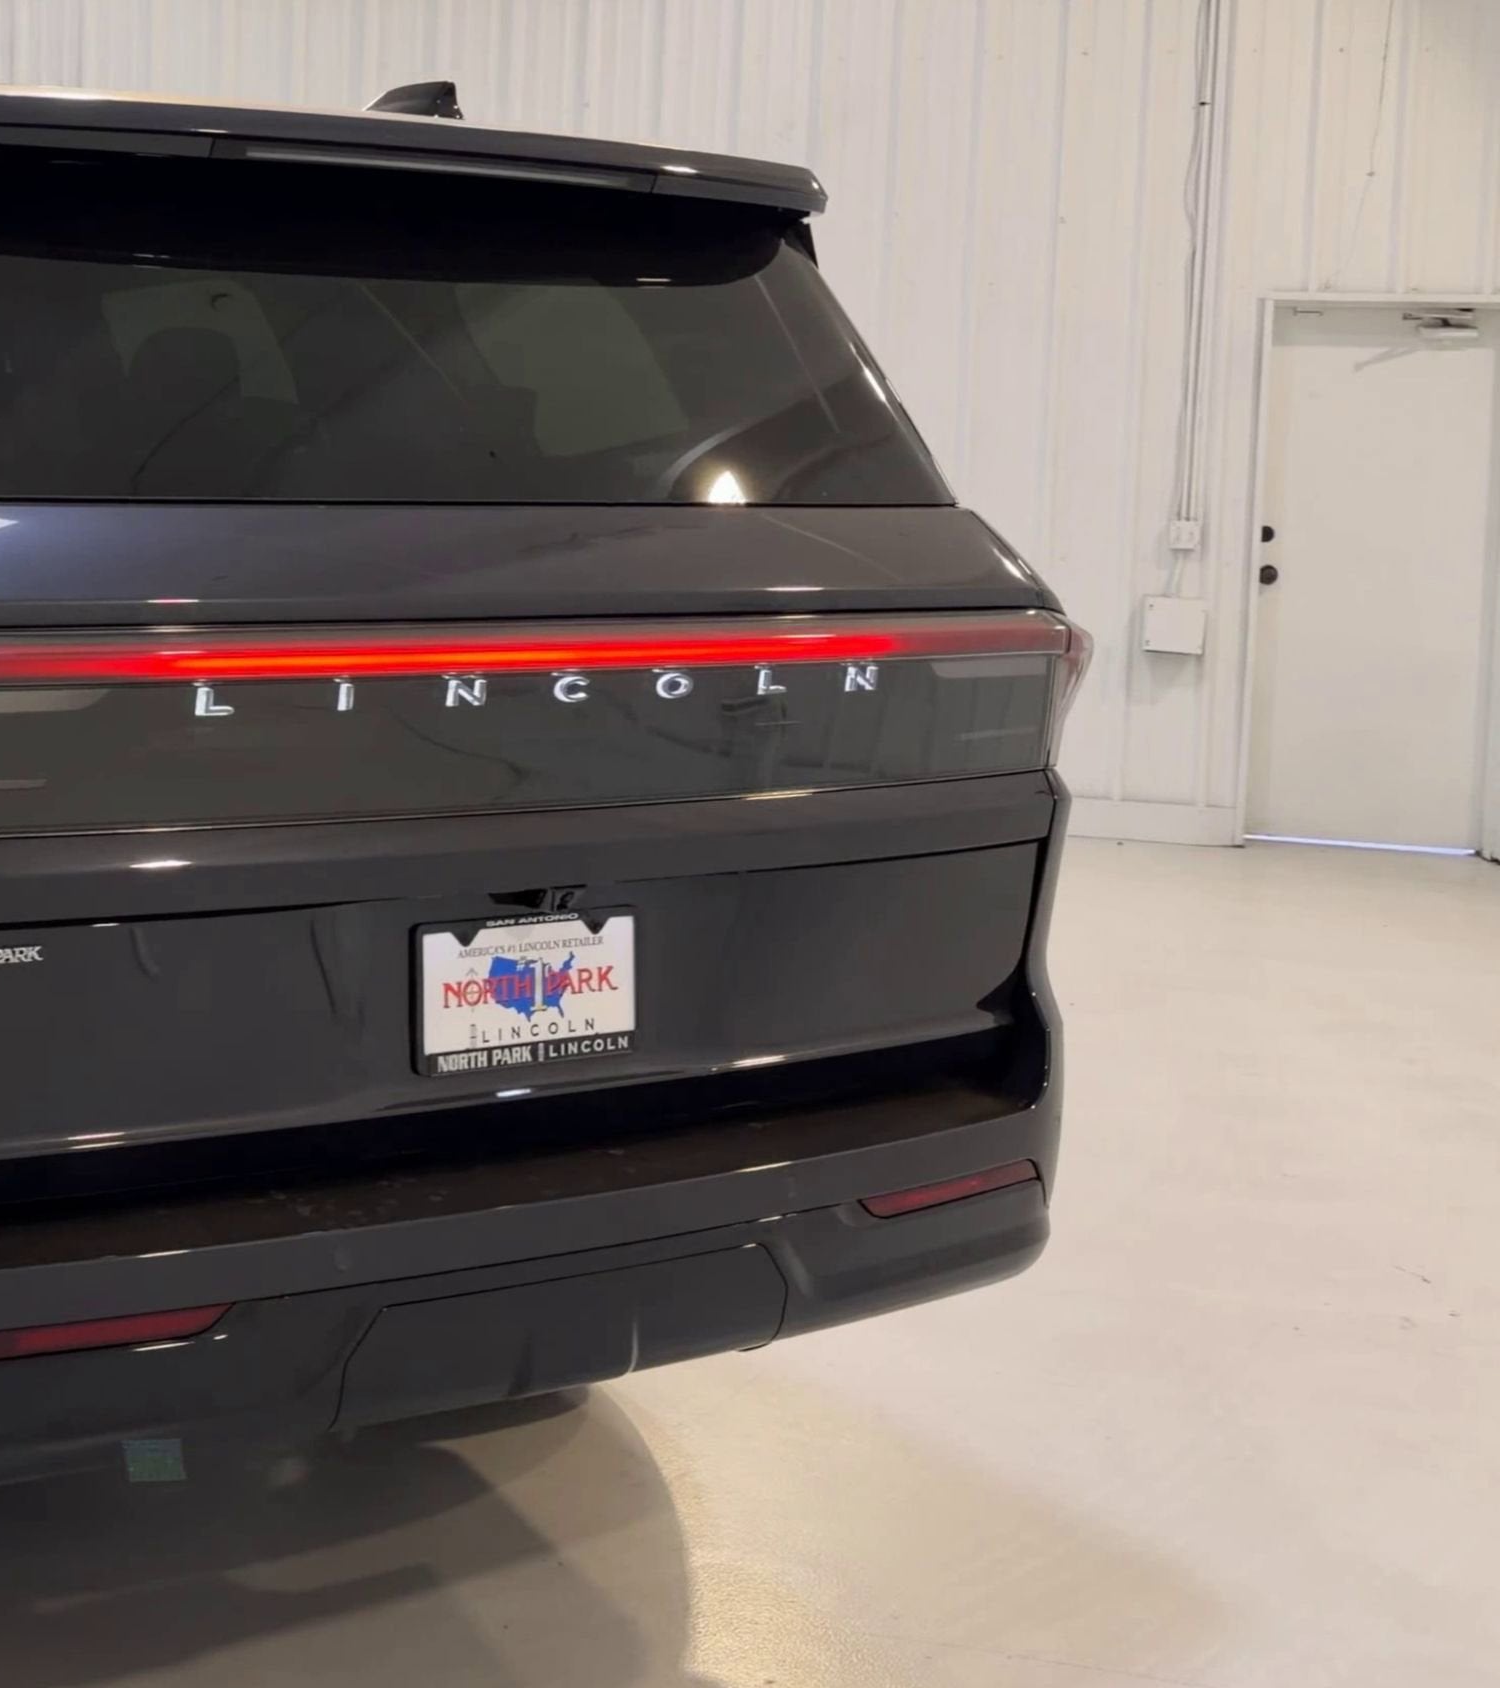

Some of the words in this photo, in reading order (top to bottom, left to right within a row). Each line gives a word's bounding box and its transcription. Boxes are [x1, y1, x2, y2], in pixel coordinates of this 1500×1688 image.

[195, 665, 879, 716] LINCOLN
[486, 918, 515, 928] SAN
[518, 912, 579, 924] ANTONIO
[458, 944, 506, 959] AMERICA'S
[518, 939, 560, 953] LINCOLN
[562, 936, 604, 949] RETAILER
[442, 973, 532, 1009] NORTH
[547, 965, 619, 996] PARK
[481, 1018, 595, 1044] LINCOLN
[437, 1050, 488, 1073] NORTH
[492, 1046, 533, 1067] PARK
[549, 1036, 630, 1058] LINCOLN
